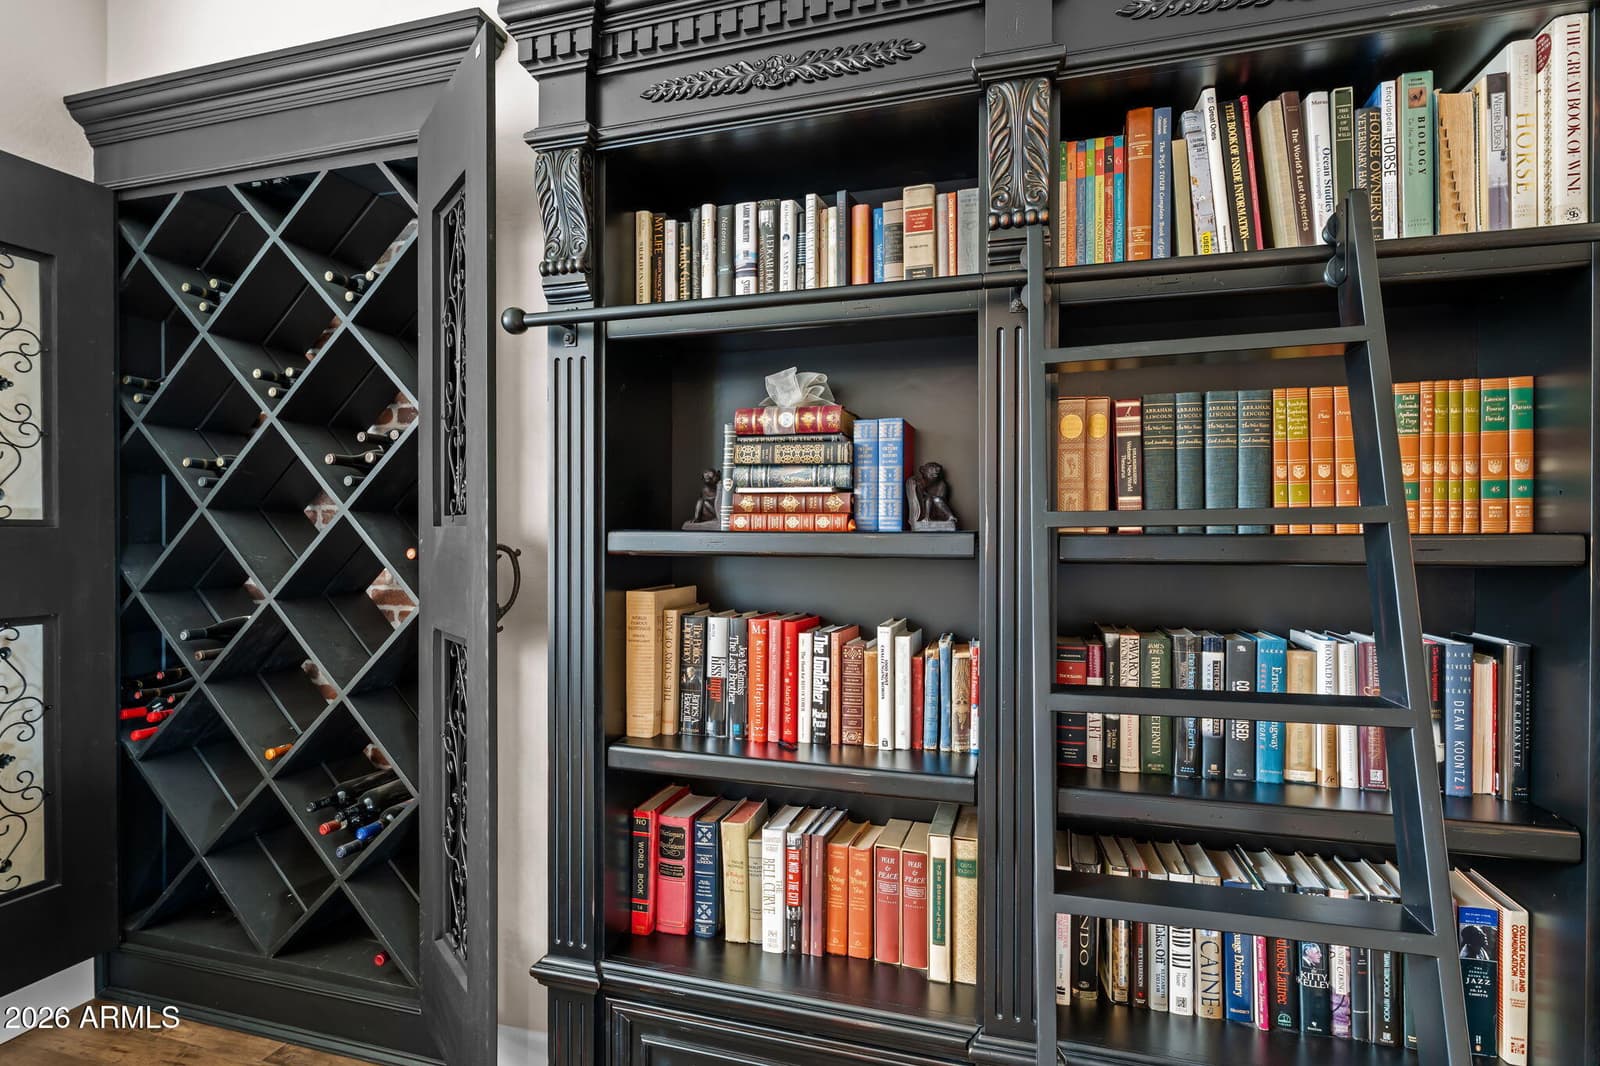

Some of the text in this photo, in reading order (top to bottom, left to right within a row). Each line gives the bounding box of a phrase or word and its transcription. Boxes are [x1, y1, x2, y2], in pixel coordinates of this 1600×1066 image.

[1208, 106, 1218, 141] Great Ones
[1493, 94, 1505, 150] WESTERN DESIGN
[1567, 22, 1581, 197] THE GREAT BOOK OF WINE
[1358, 113, 1368, 168] VETERINARY
[1384, 86, 1396, 177] Encyclopedia HORSE
[1417, 116, 1426, 176] BIOLOGY
[1107, 155, 1113, 164] 5
[1225, 103, 1250, 240] THE BOOK OF INSIDE INFORMATION
[1369, 112, 1381, 222] HORSE OWNER'S
[1516, 112, 1535, 194] HORSE
[1291, 129, 1310, 232] The World's Last Mysteries
[1323, 147, 1334, 213] Ocean Studies
[1158, 192, 1166, 219] Complete
[653, 217, 664, 256] MY LIFE
[721, 216, 729, 255] Notorious
[1157, 245, 1165, 258] Golf
[678, 244, 691, 270] Judy
[681, 623, 693, 664] Diplomacy
[693, 623, 703, 664] The Politics
[751, 624, 767, 634] Me
[664, 616, 673, 702] THE STORY OF ART
[728, 635, 738, 705] The Last Brother
[737, 644, 747, 695] Joe McGinniss
[813, 634, 829, 705] The Godfather
[1120, 637, 1128, 669] MY OWN
[1151, 657, 1161, 681] FROM
[1324, 644, 1333, 679] RONALD
[754, 640, 764, 724] Katharine Hepburn
[784, 685, 792, 705] Marley
[683, 692, 692, 714] Baker
[692, 693, 701, 716] James
[1514, 664, 1522, 768] WALTER CRONKITE
[1088, 715, 1102, 742] ART
[1151, 716, 1161, 757] ETERNITY
[1188, 729, 1197, 750] Earth
[1454, 701, 1465, 783] DEAN KOONTZ
[787, 850, 800, 906] THE MOB THE CITY
[878, 871, 898, 881] PEACE
[880, 856, 896, 865] WAR
[904, 876, 926, 884] PEACE
[907, 861, 923, 869] WAR
[763, 858, 776, 915] BELL CURVE
[1155, 948, 1166, 966] Off
[1518, 925, 1526, 953] COLLEGE
[1200, 940, 1220, 1007] CAINE
[1232, 955, 1244, 998] Dictionary
[1296, 977, 1329, 989] KELLEY
[1299, 971, 1328, 982] KITTY
[1465, 977, 1491, 986] JAZZ
